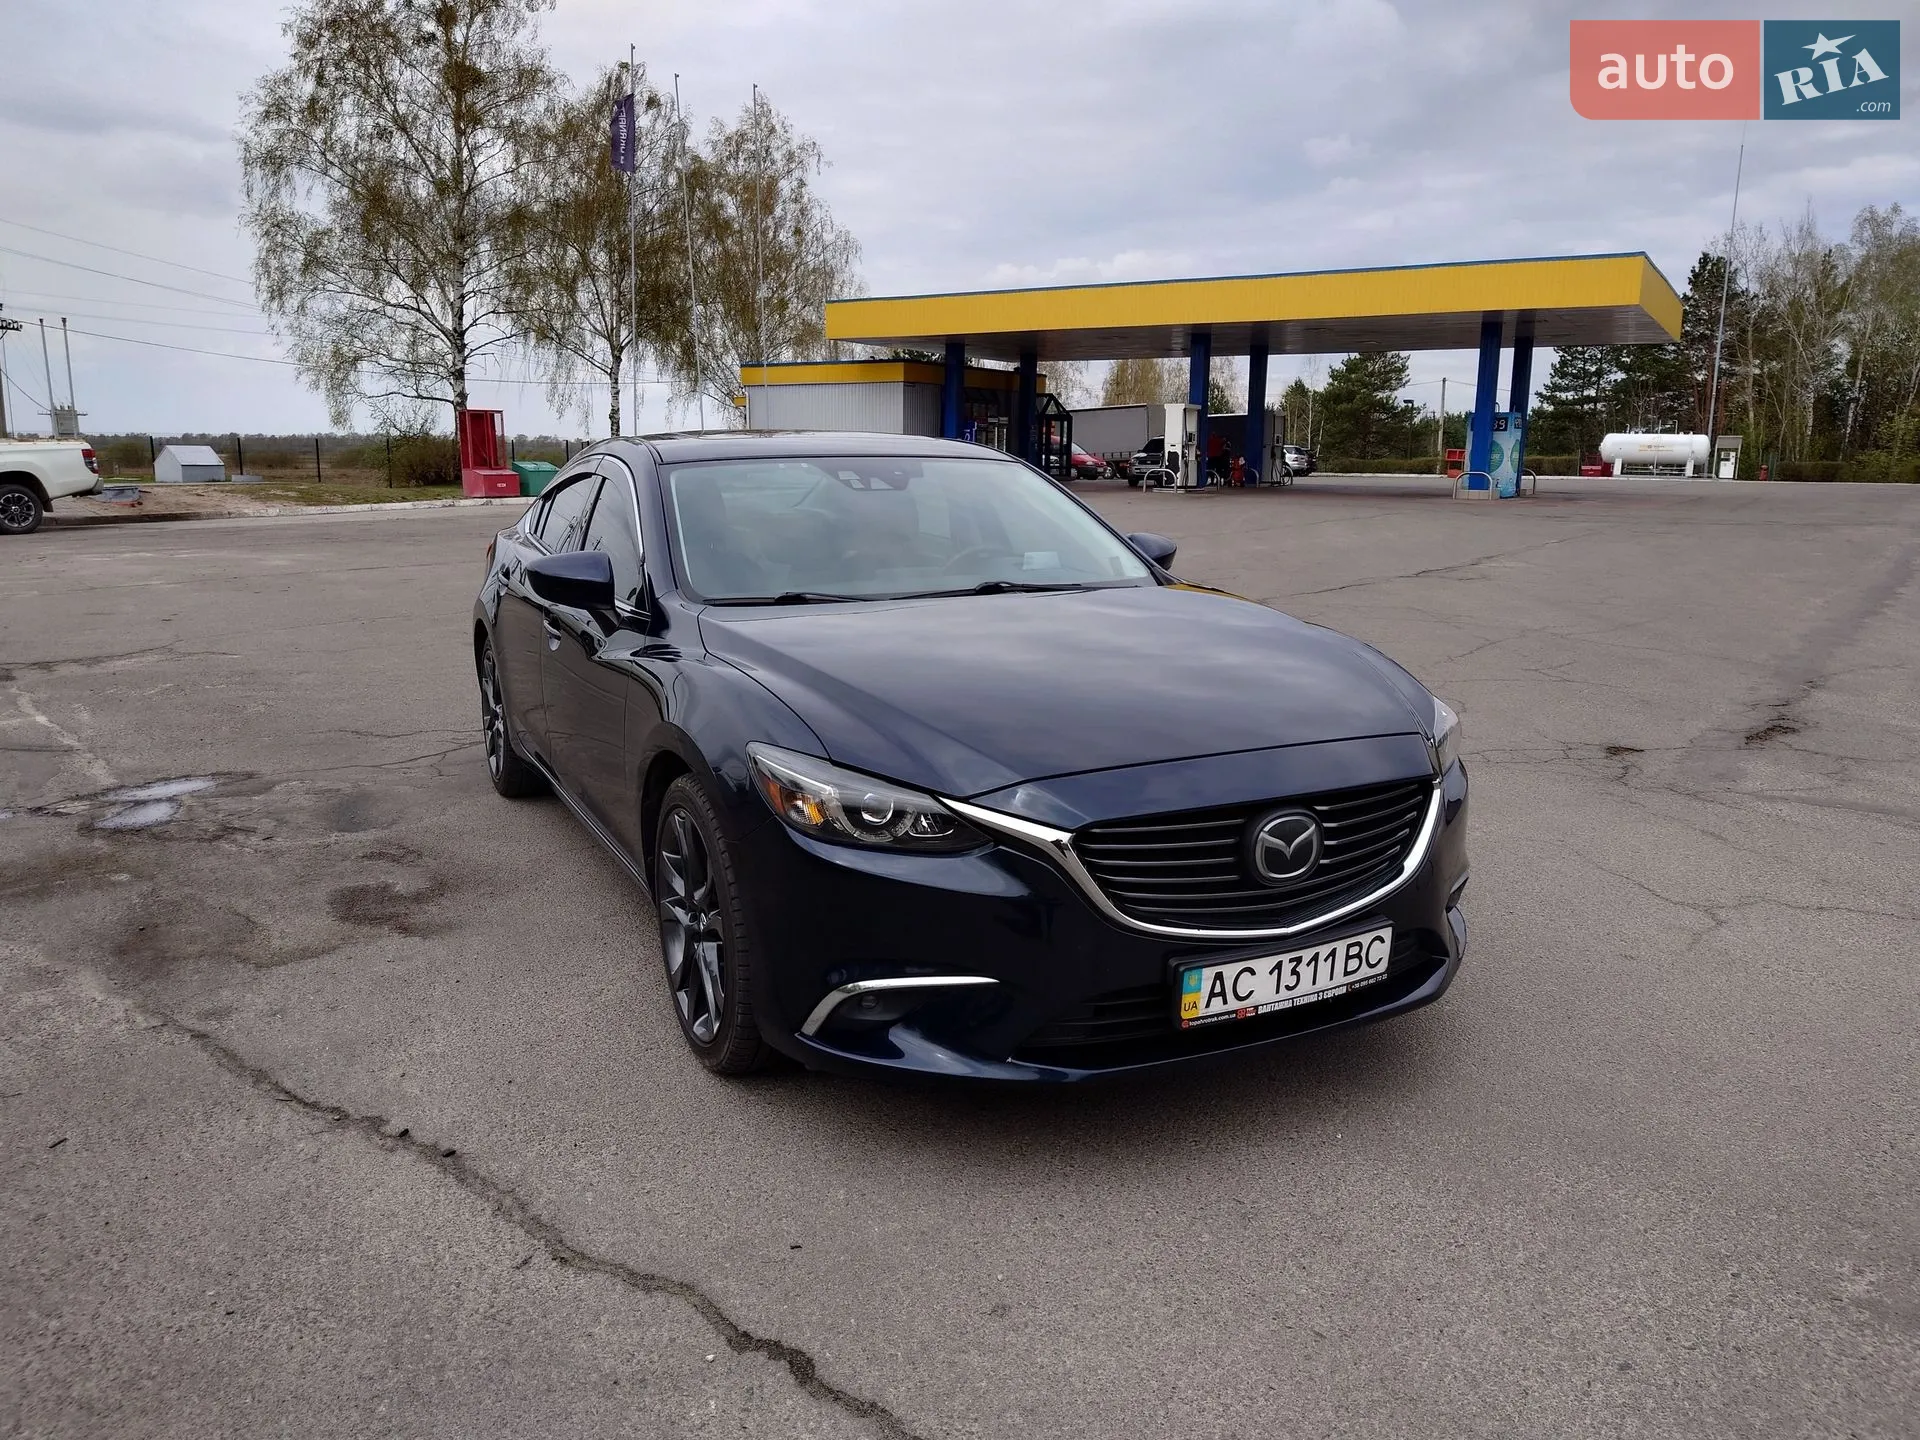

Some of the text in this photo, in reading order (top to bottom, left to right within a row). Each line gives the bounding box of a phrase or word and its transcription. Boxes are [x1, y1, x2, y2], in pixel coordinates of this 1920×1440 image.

[1204, 935, 1386, 1009] AC 1311 BC
[1183, 1002, 1198, 1012] UA
